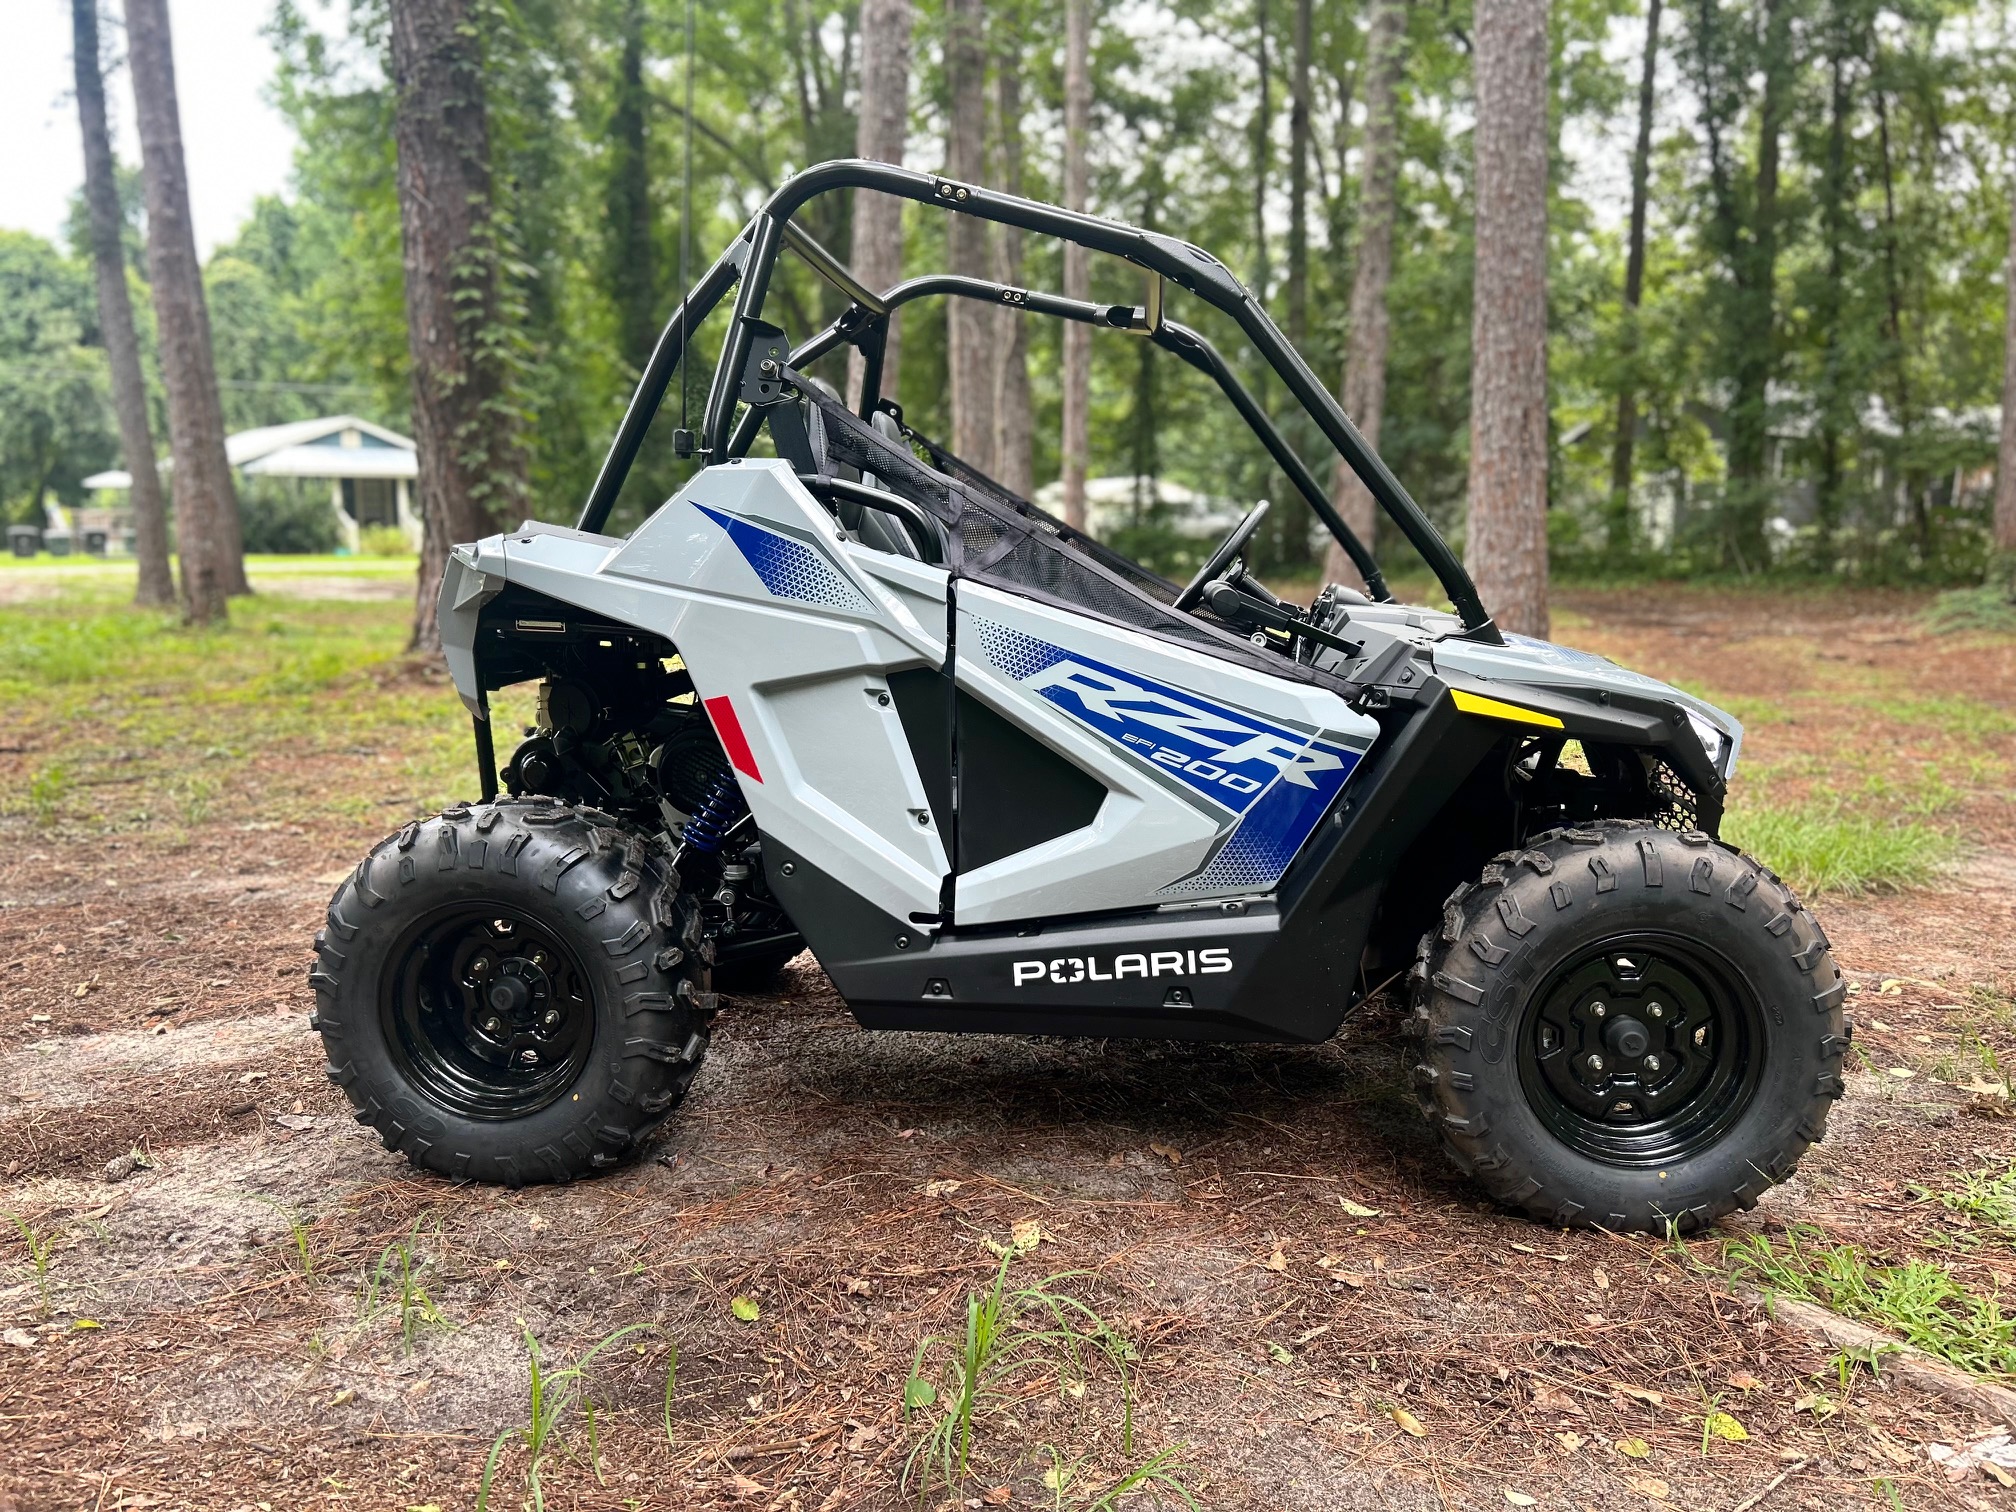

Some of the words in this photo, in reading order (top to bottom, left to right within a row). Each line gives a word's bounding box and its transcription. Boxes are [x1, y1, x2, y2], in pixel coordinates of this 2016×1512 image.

[1032, 660, 1344, 790] RZR
[1121, 733, 1155, 750] EFI
[1150, 747, 1262, 794] 200
[1013, 948, 1232, 986] POLARIS
[1478, 941, 1538, 1064] CST
[366, 1079, 447, 1139] CST
